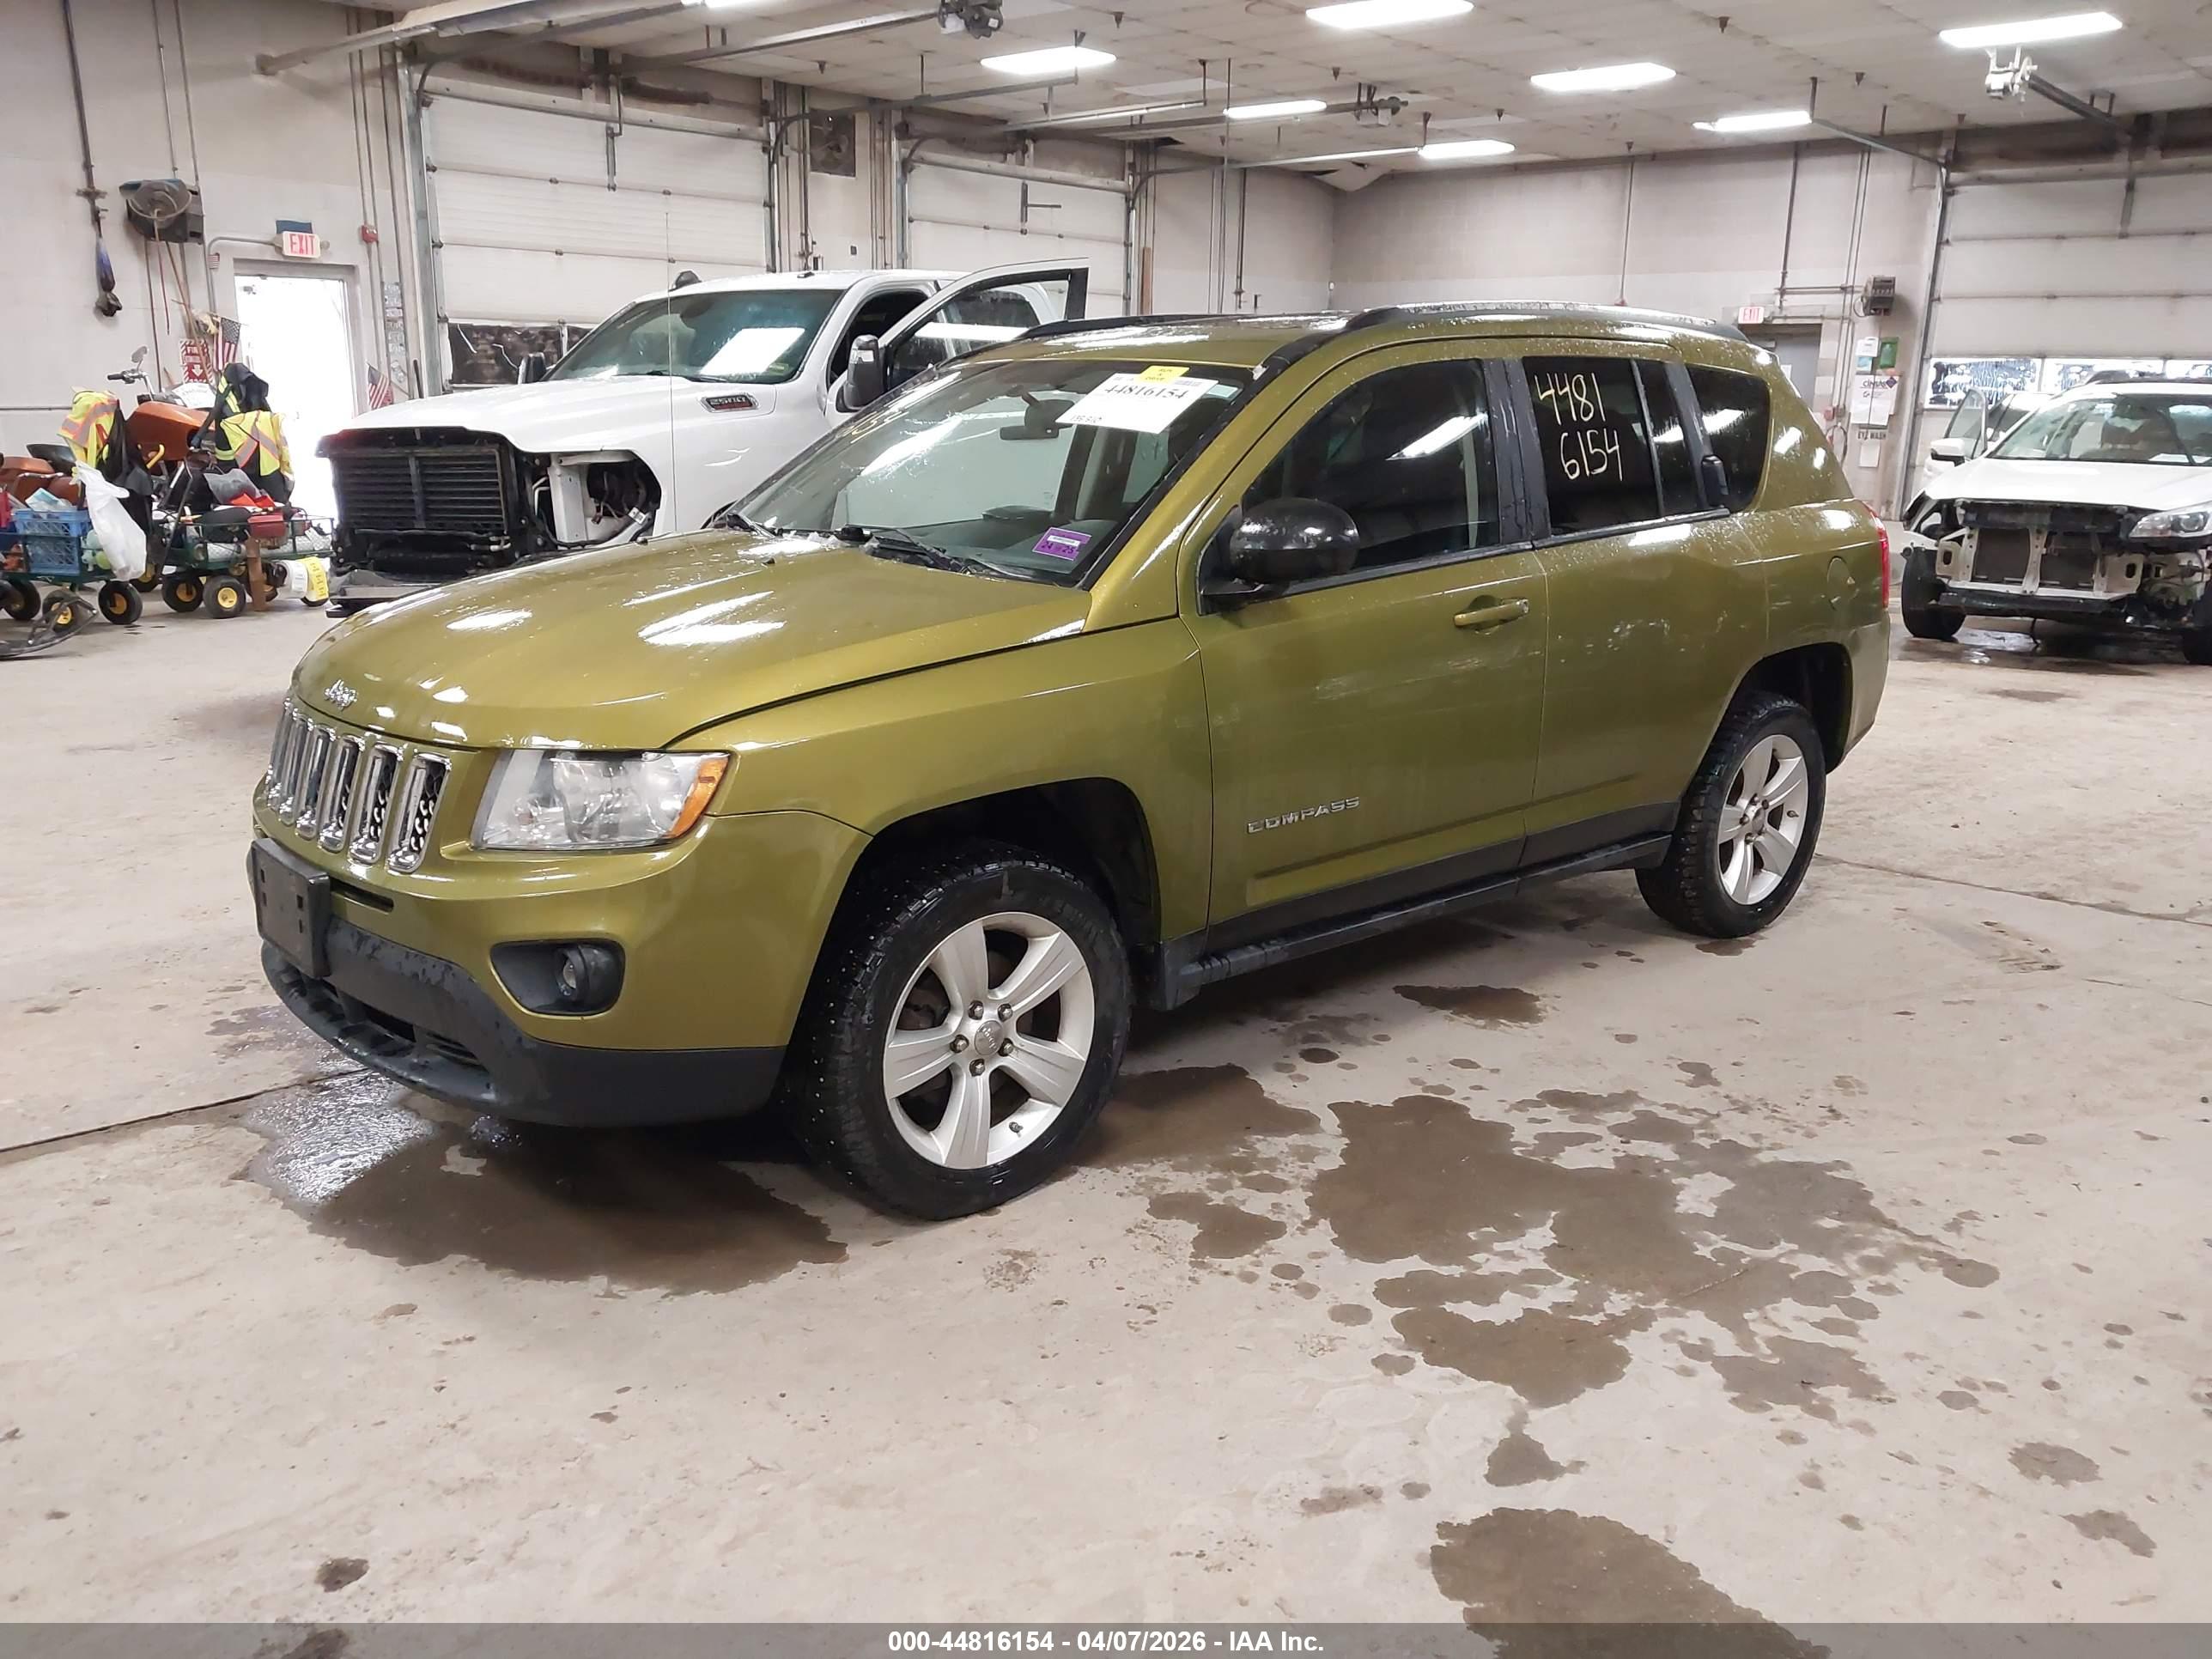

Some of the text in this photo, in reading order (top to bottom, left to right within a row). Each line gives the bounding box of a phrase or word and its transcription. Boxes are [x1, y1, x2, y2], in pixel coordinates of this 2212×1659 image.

[289, 233, 315, 255] EXIT
[1743, 307, 1759, 322] EXIT
[1104, 384, 1189, 399] 44816154
[1534, 372, 1607, 426] 4481
[1559, 428, 1623, 482] 6154
[1248, 796, 1360, 834] COMPASS
